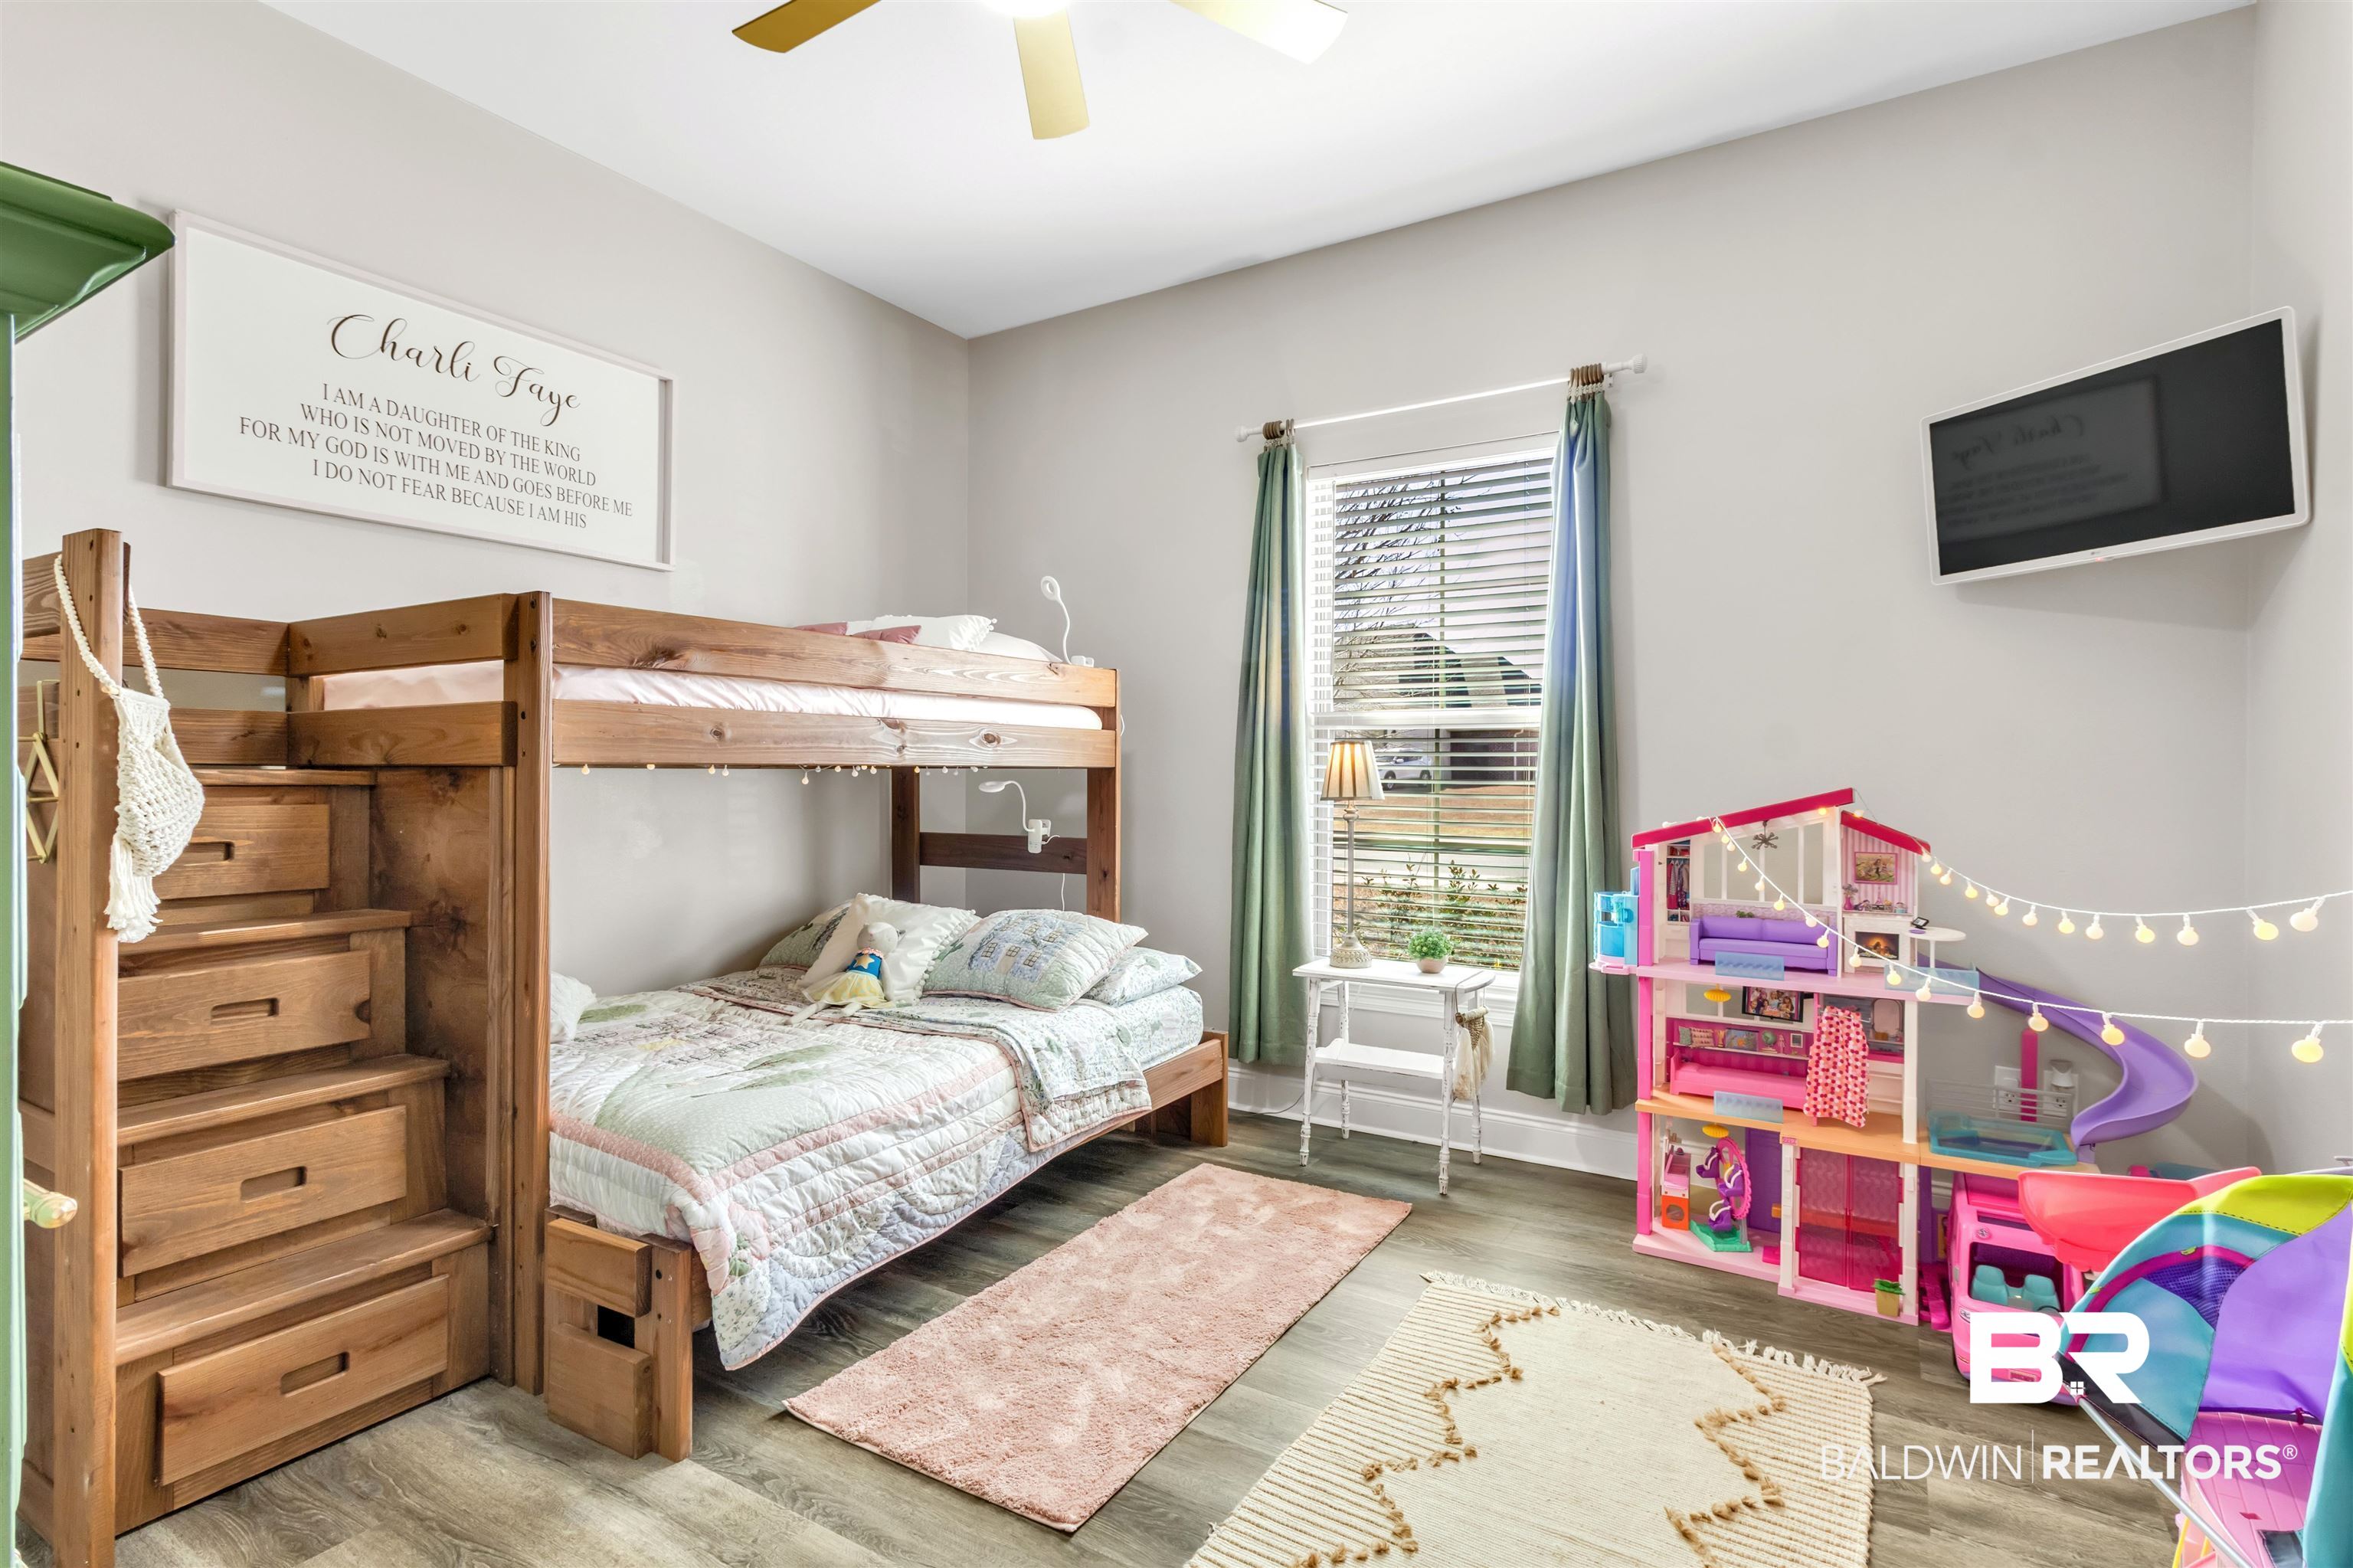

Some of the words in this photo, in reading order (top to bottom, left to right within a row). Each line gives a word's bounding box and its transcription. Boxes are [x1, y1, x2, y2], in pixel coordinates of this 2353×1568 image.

[327, 314, 480, 381] Charli
[493, 355, 581, 427] Faye
[300, 403, 348, 430] WHO
[353, 416, 369, 435] IS
[375, 421, 414, 444] NOT
[417, 431, 481, 460] MOVED
[485, 447, 506, 466] BY
[509, 453, 540, 474] THE
[543, 460, 597, 486] WORLD
[323, 384, 329, 401] I
[333, 388, 365, 410] AM
[369, 397, 381, 414] A
[386, 399, 482, 438] DAUGHTER
[486, 425, 507, 443] OF
[511, 430, 541, 452] THE
[545, 440, 581, 462] KING
[239, 416, 283, 443] FOR
[287, 427, 320, 450] MY
[325, 435, 368, 460] GOD
[373, 446, 389, 465] IS
[394, 450, 440, 476] WITH
[445, 461, 471, 482] ME
[473, 469, 509, 490] AND
[512, 476, 552, 499] GOES
[556, 486, 610, 512] BEFORE
[613, 499, 633, 516] ME
[313, 459, 319, 476] I
[326, 461, 353, 483] DO
[358, 467, 398, 491] NOT
[401, 476, 447, 502] FEAR
[451, 486, 525, 516] BECAUSE
[529, 502, 534, 519] I
[537, 506, 561, 523] AM
[564, 509, 587, 529] HIS
